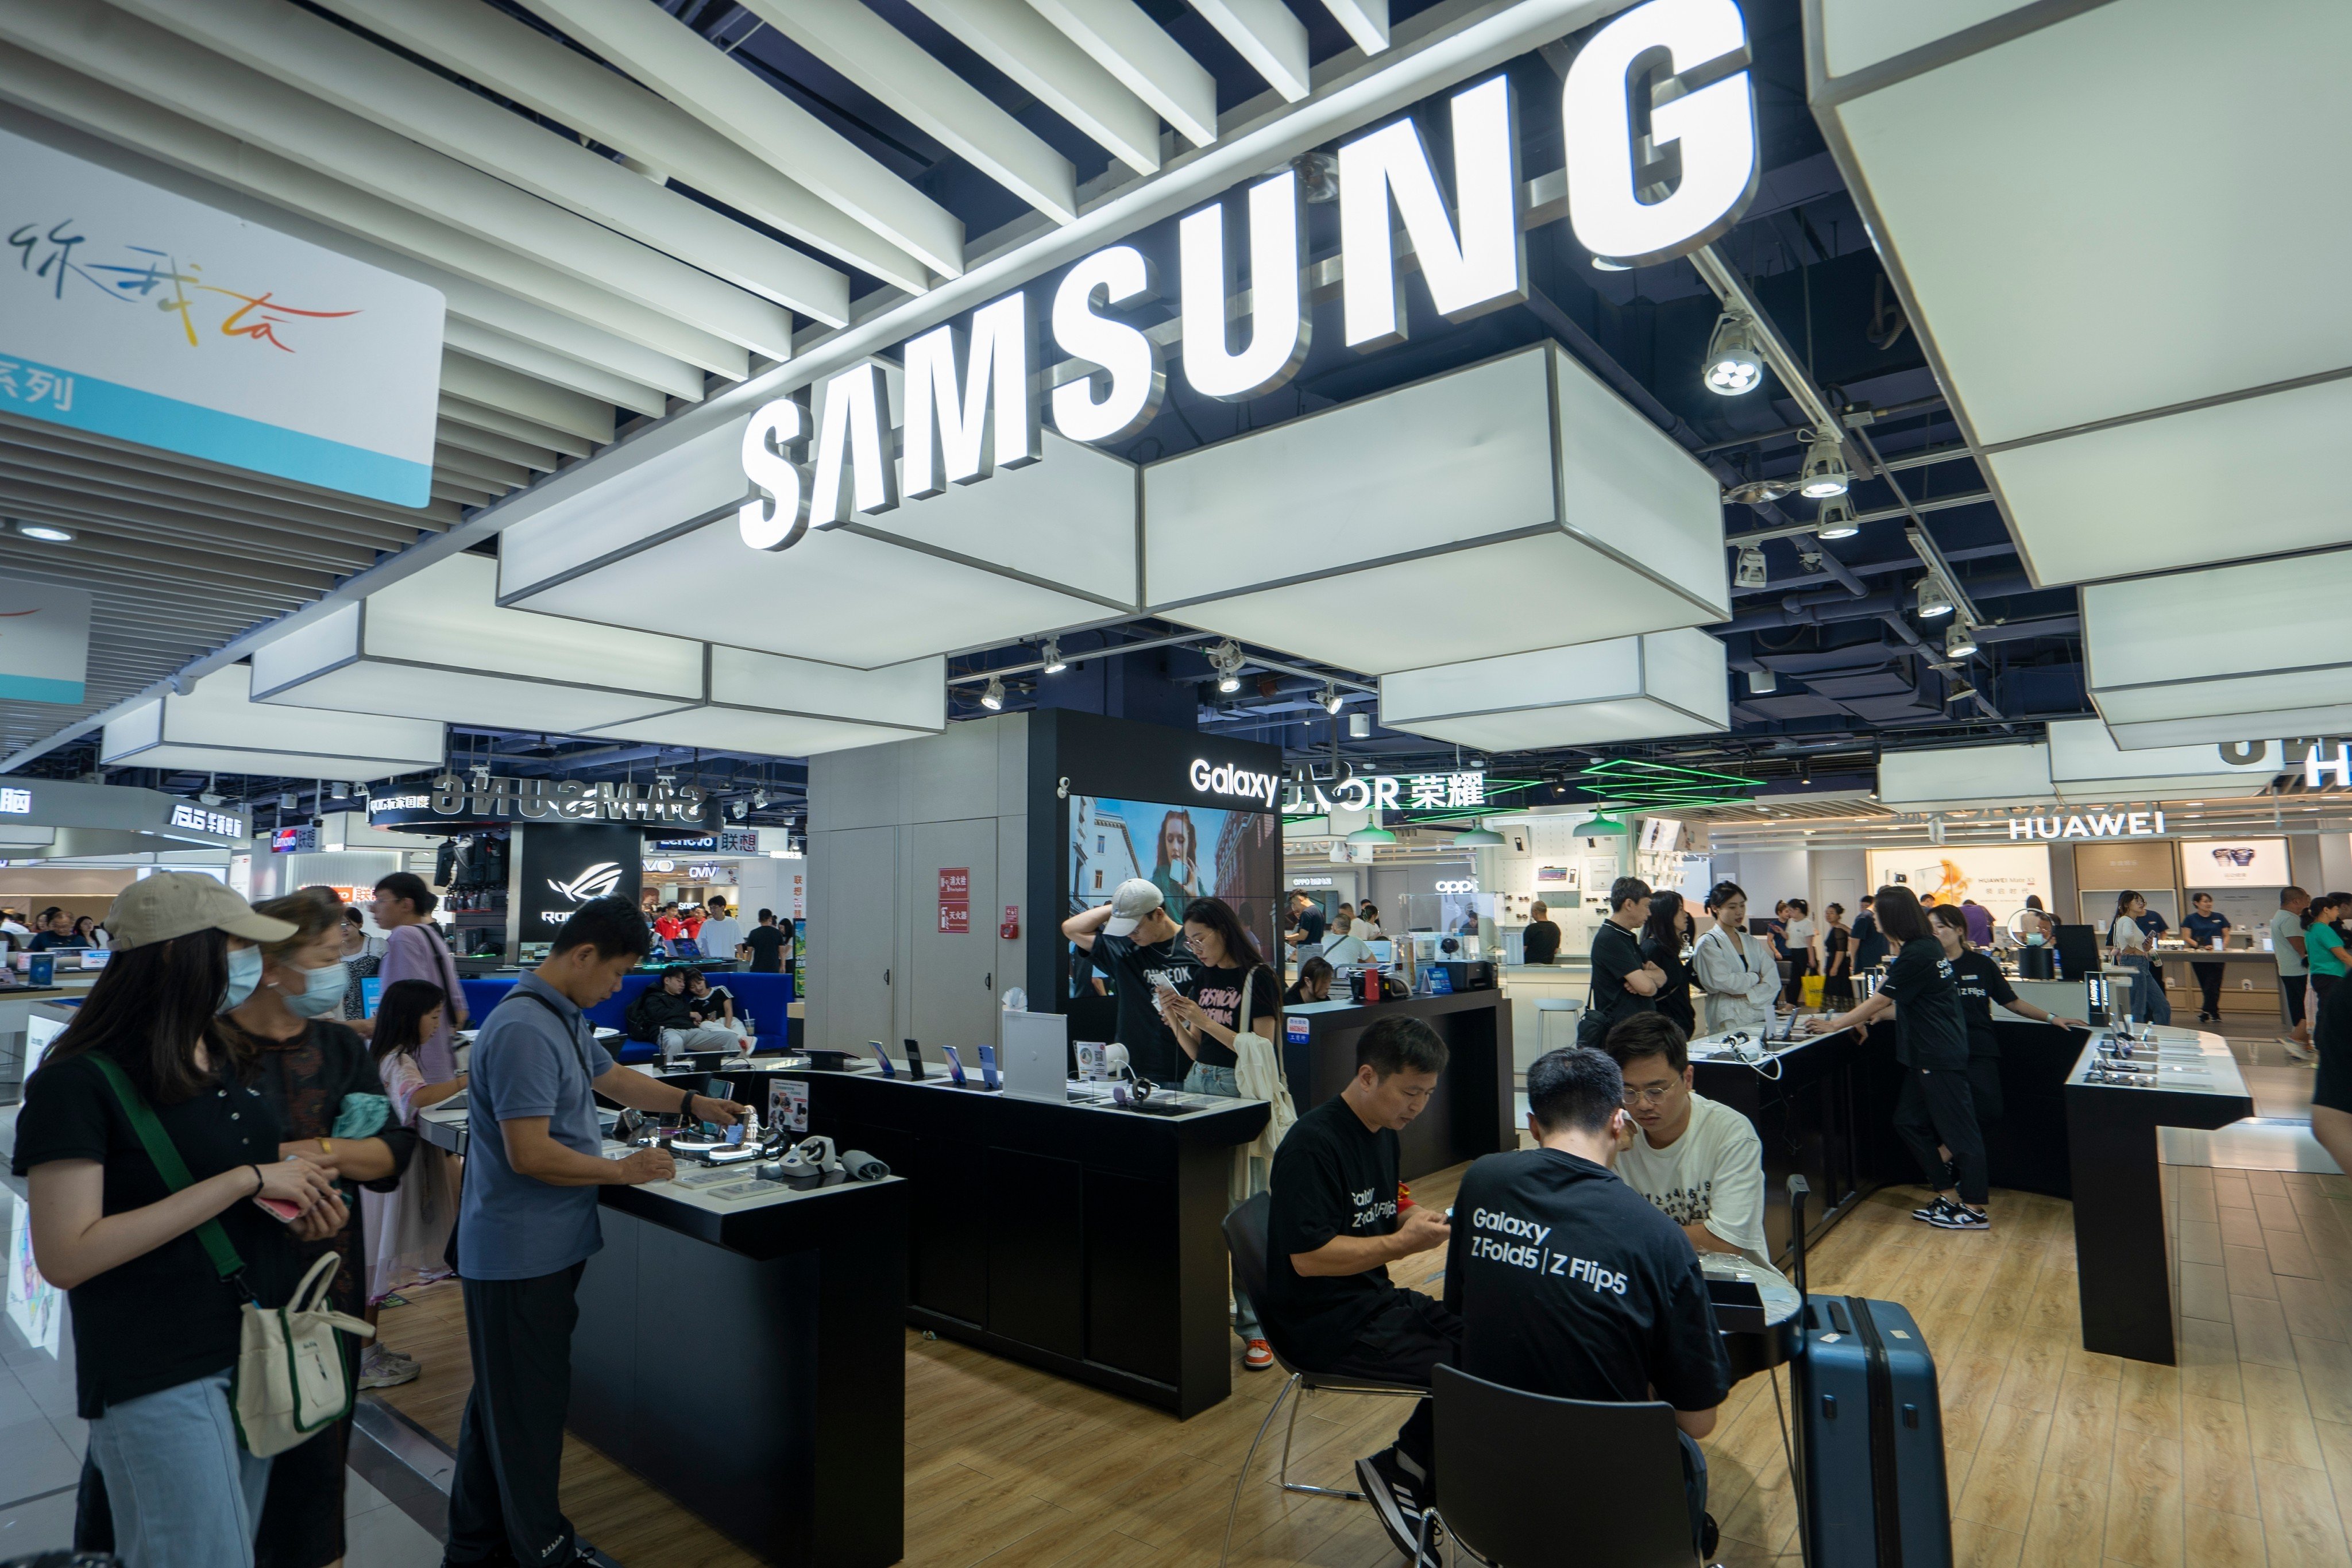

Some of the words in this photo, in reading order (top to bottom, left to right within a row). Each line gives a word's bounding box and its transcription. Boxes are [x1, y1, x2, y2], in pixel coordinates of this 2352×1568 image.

[739, 0, 1759, 550] SAMSUNG
[1190, 759, 1279, 808] Galaxy
[1410, 773, 1485, 809] 荣耀
[721, 833, 756, 852] 联想
[2009, 811, 2165, 840] HUAWEI
[1435, 880, 1474, 894] opp
[1473, 1208, 1551, 1246] Galaxy
[1471, 1236, 1481, 1257] Z
[1481, 1238, 1539, 1269] Fold5
[1550, 1253, 1568, 1276] Z
[1569, 1257, 1628, 1295] Flip5
